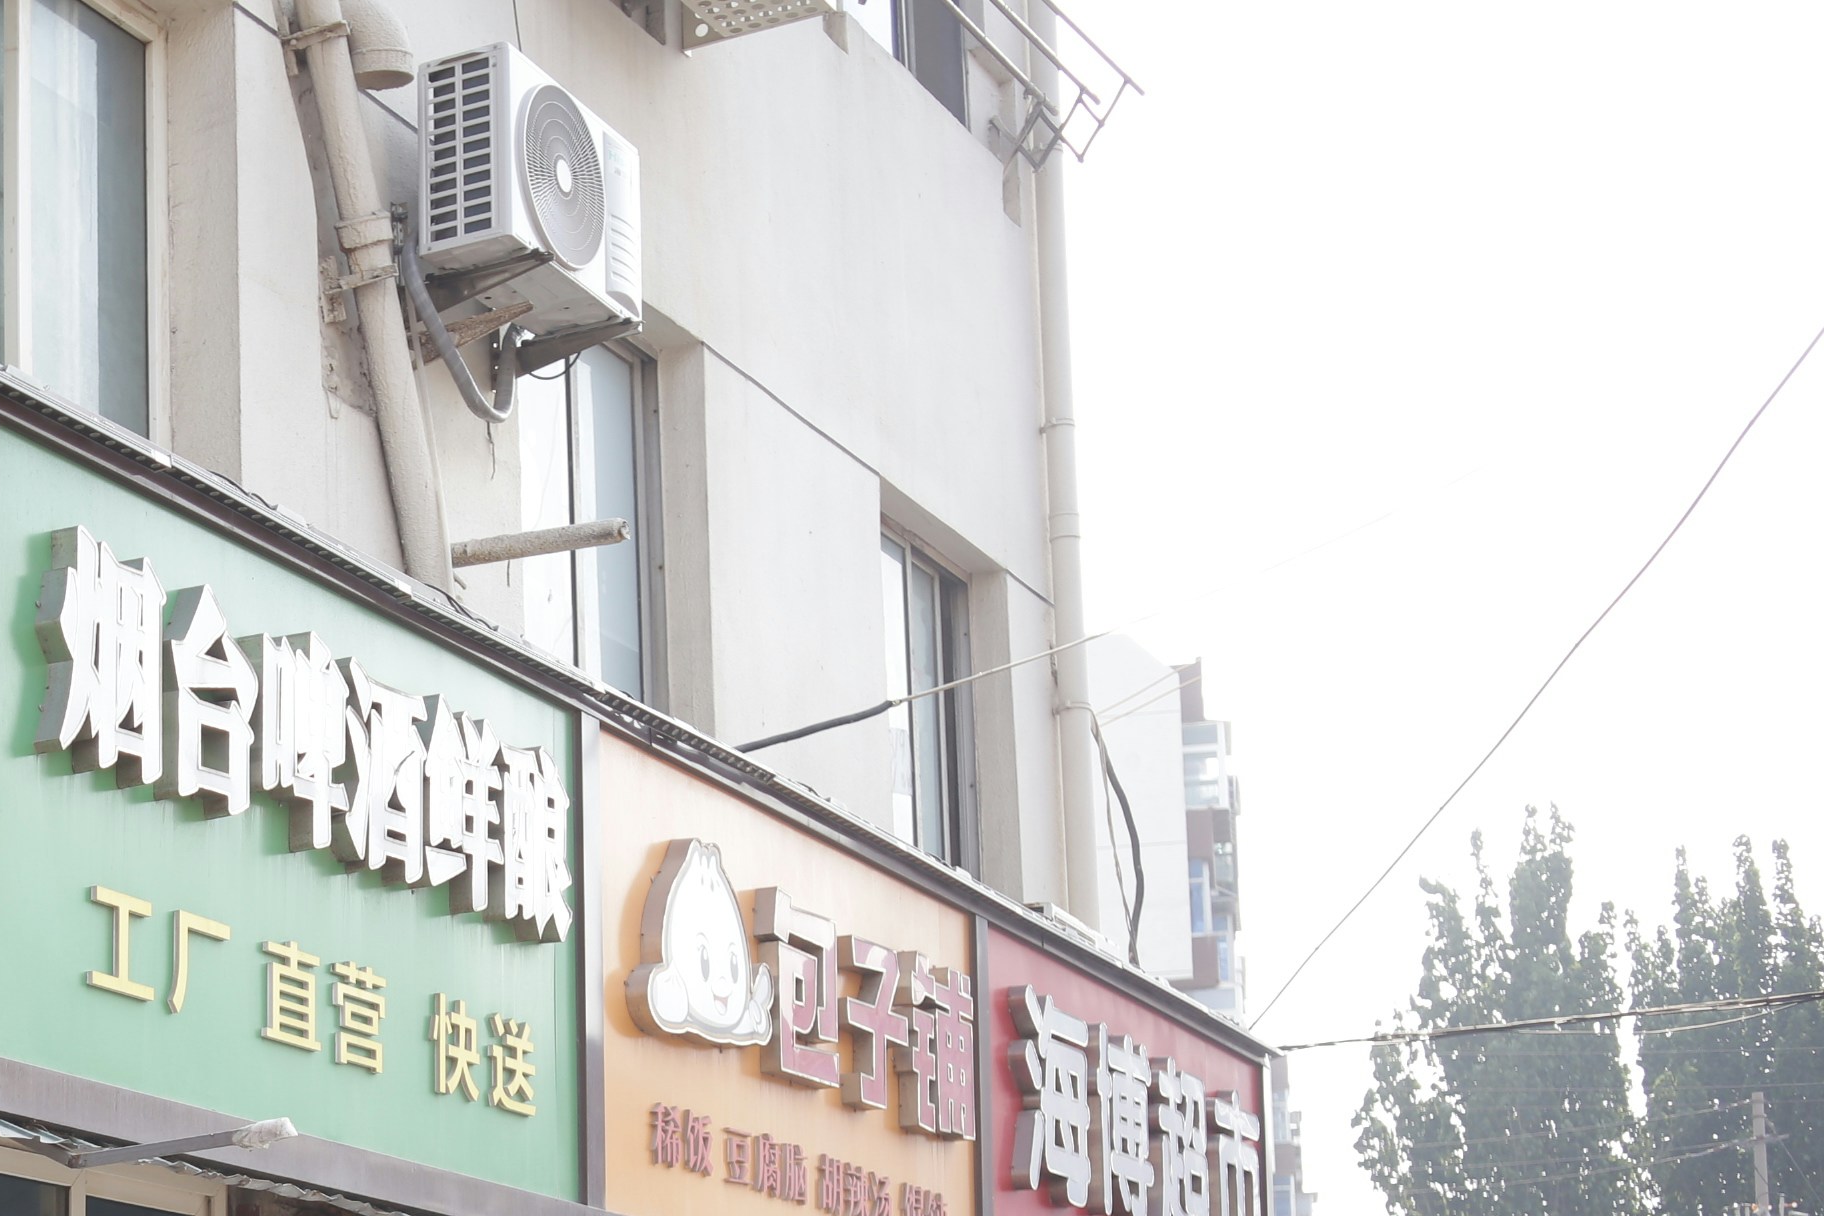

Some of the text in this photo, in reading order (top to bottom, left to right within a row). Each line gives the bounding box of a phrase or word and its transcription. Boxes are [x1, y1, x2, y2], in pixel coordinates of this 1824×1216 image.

[60, 524, 573, 943] 烟台啤酒鲜酿
[85, 884, 537, 1118] 工厂 直营 快送
[774, 886, 976, 1141] 包子铺
[649, 1102, 714, 1177] 稀饭
[723, 1126, 809, 1205] 豆腐脑
